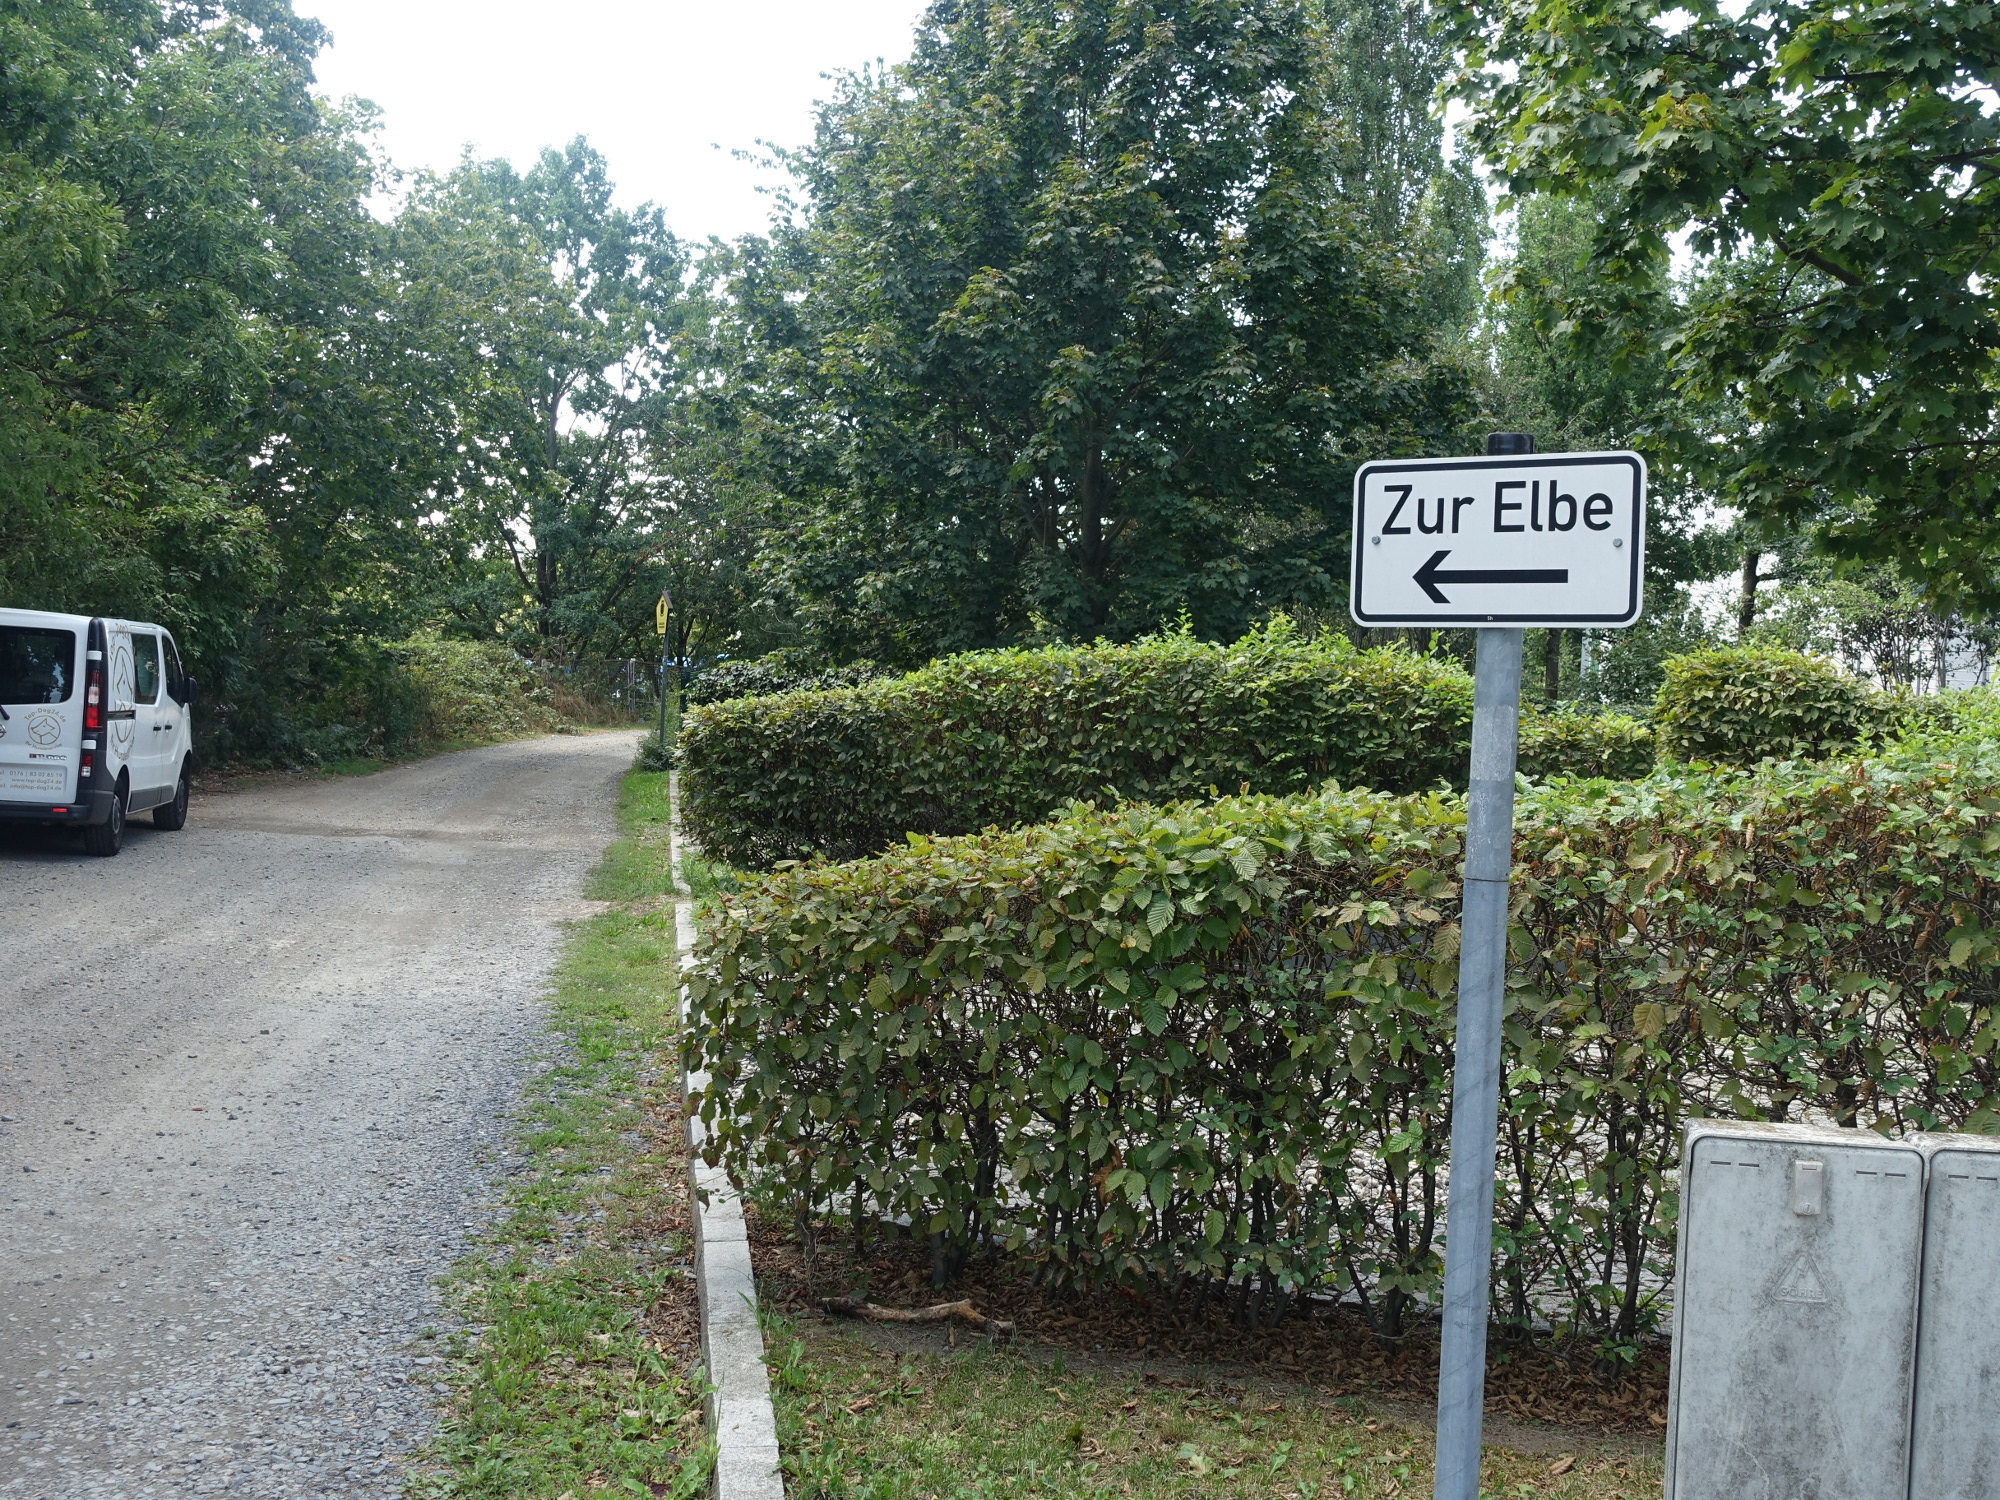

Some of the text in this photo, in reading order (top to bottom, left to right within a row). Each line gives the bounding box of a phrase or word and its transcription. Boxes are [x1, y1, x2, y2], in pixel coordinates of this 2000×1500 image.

[1382, 480, 1613, 535] Zur Elbe
[24, 708, 66, 723] Top-Dog24.de
[11, 777, 62, 785] www.top-dog24.de
